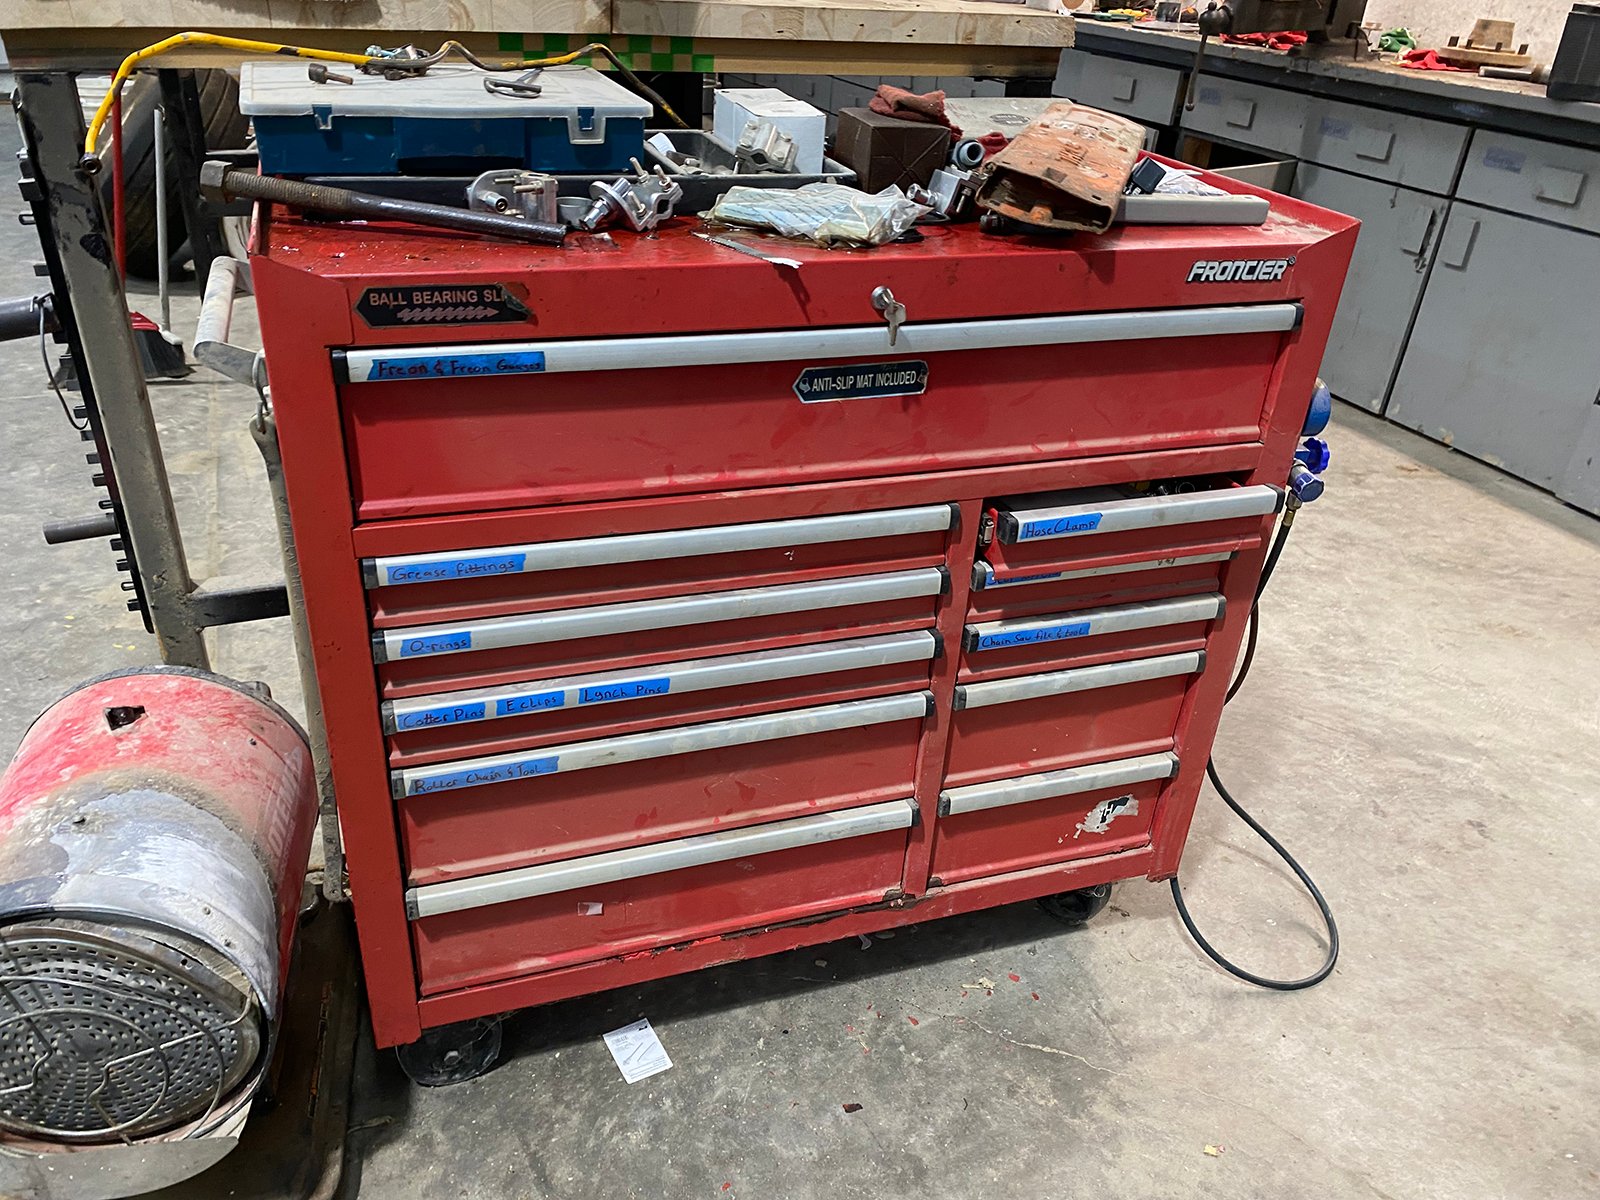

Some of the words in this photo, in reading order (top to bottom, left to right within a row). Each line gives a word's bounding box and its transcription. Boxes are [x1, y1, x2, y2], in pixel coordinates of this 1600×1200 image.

[1185, 259, 1289, 282] FRONTIER
[369, 291, 407, 307] BALL
[413, 289, 478, 304] BEARING
[377, 361, 426, 377] Freon
[450, 360, 492, 374] Freon
[811, 376, 855, 392] ANTI-SLIP
[856, 374, 874, 388] MAT
[875, 370, 917, 387] INCLUDED
[392, 567, 447, 581] Grease
[410, 639, 468, 653] O-rings
[981, 636, 1011, 648] Chain
[1064, 628, 1086, 638] tool
[584, 689, 628, 703] Lynch
[636, 684, 664, 696] Pins
[403, 713, 448, 728] Cotter
[453, 708, 486, 721] Pins
[414, 778, 458, 793] Roller
[466, 771, 502, 784] Chain
